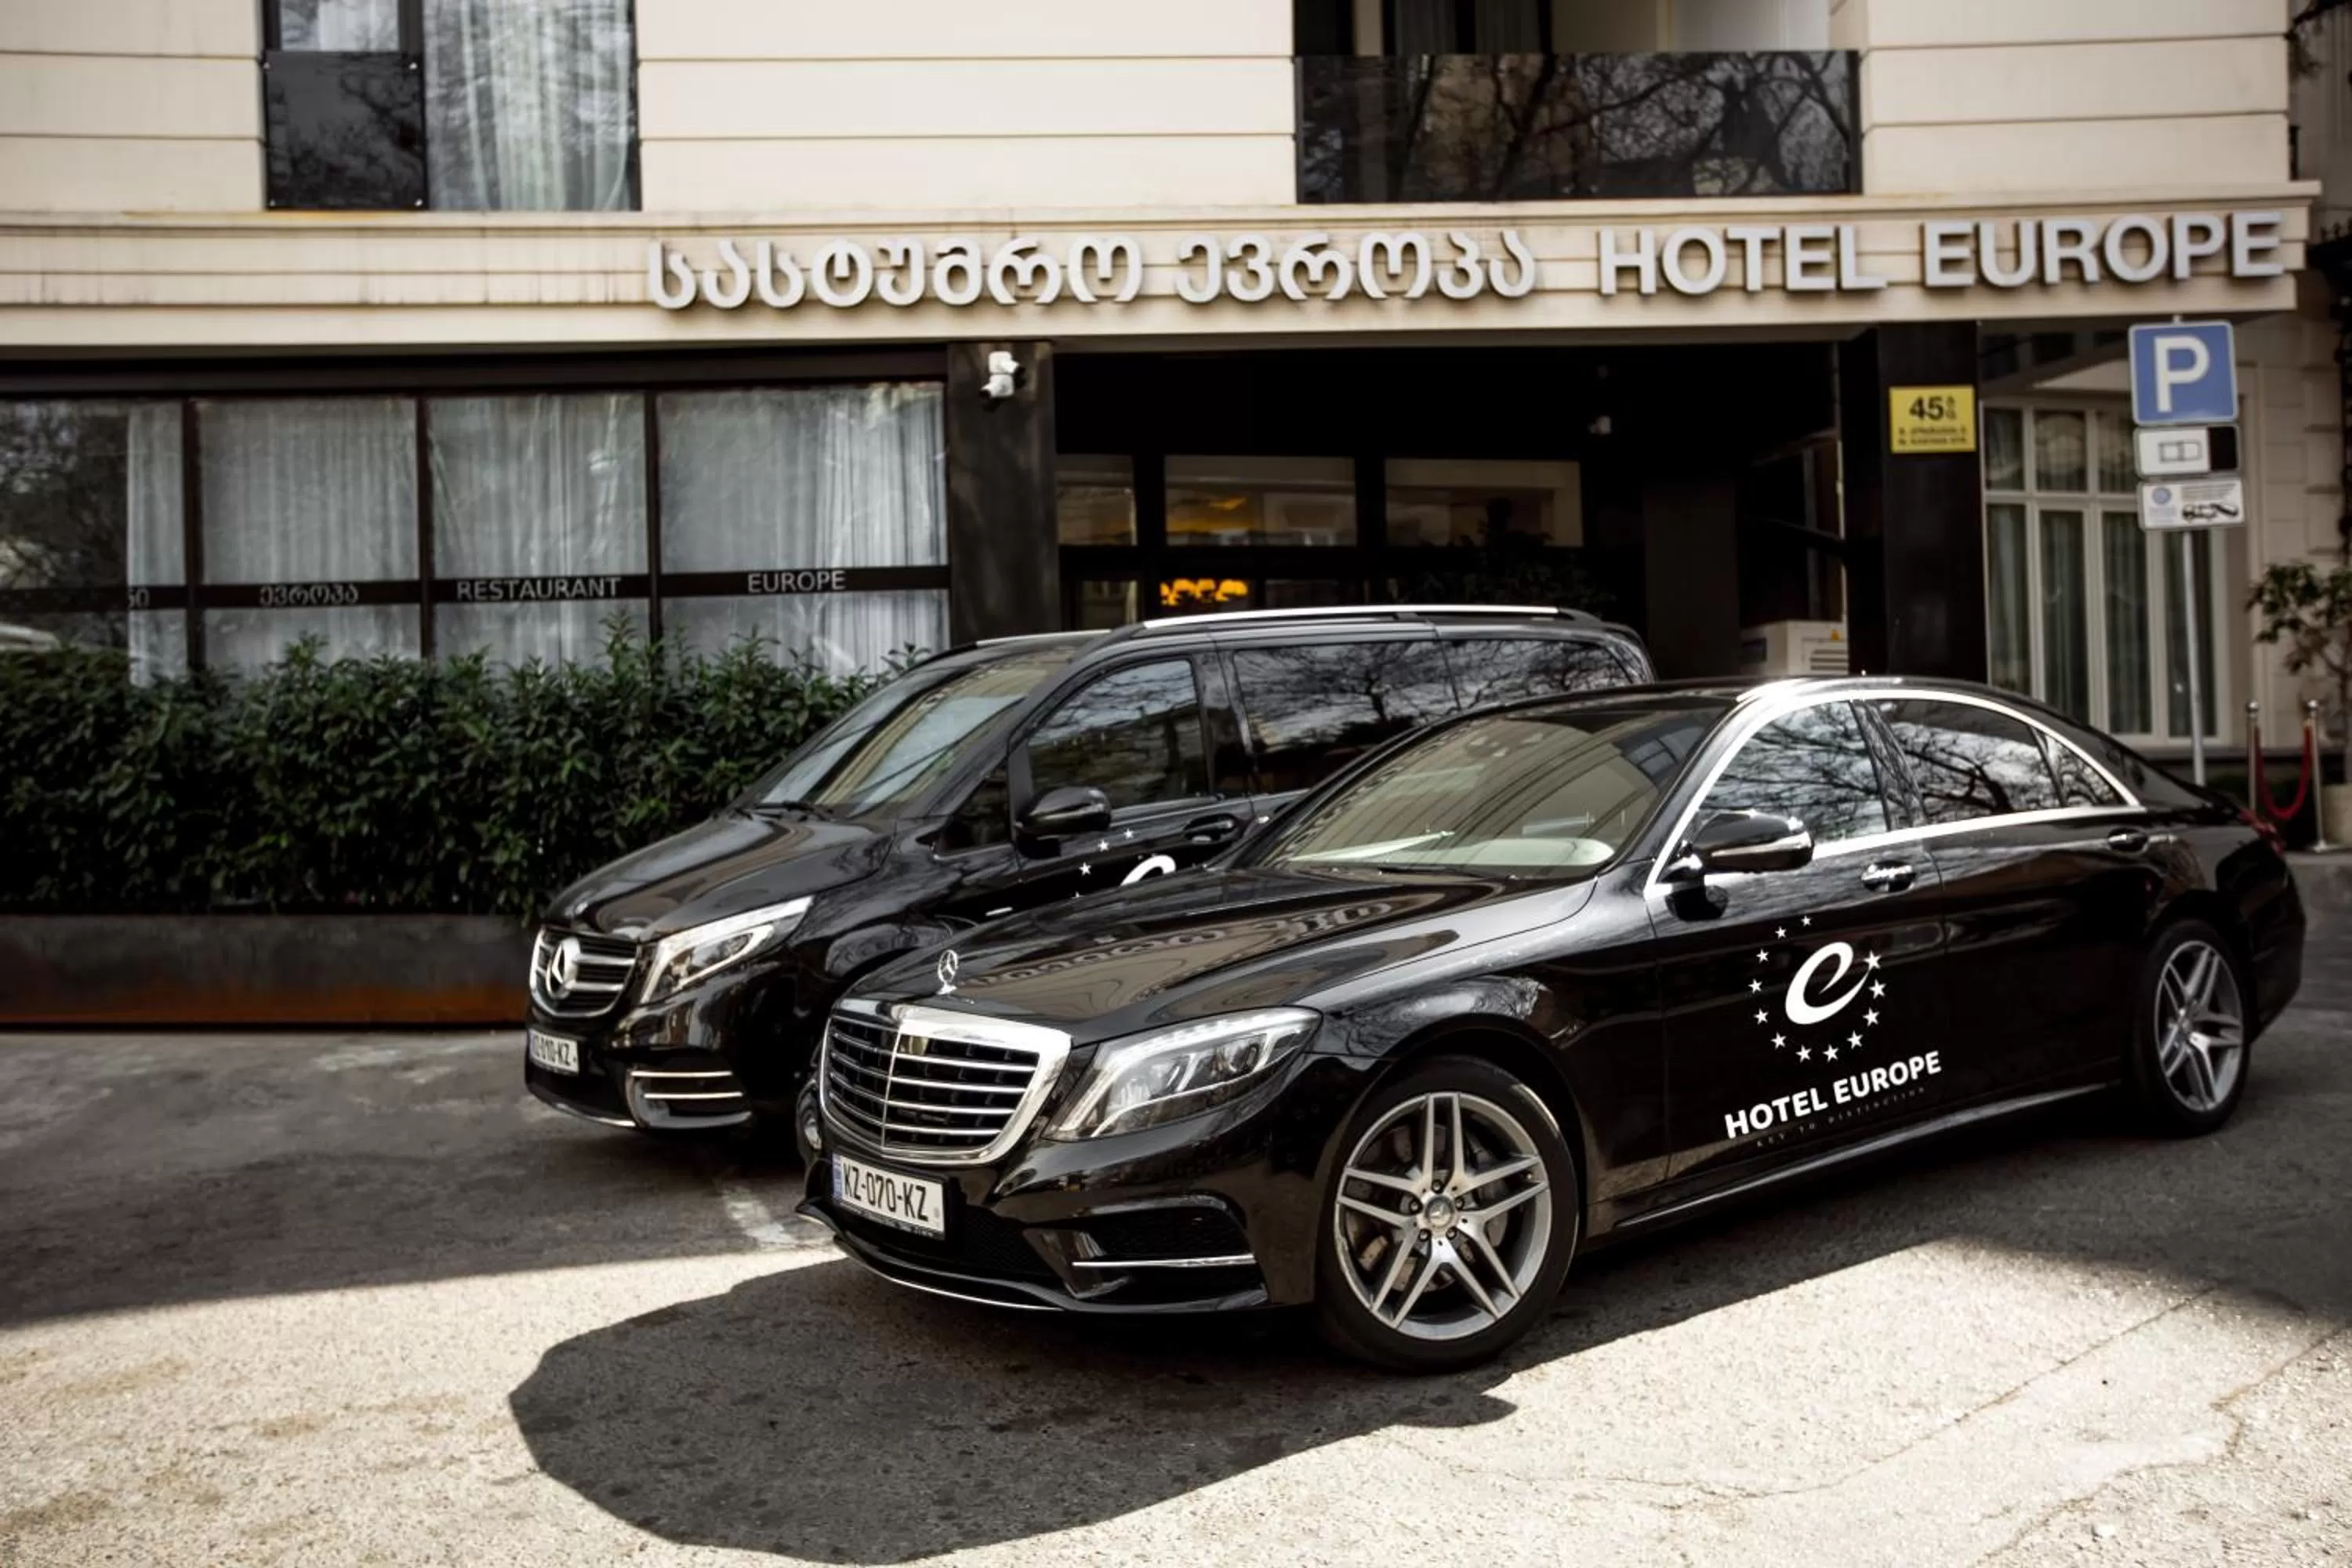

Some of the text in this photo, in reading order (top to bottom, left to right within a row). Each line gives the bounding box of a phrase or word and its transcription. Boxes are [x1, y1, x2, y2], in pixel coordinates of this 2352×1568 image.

[648, 230, 1535, 309] სასტუმრო ევროპა
[1599, 211, 2285, 296] HOTEL EUROPE
[2154, 336, 2209, 414] P
[457, 578, 621, 601] RESTAURANT
[747, 570, 847, 593] EUROPE
[1725, 1051, 1942, 1139] HOTEL EUROPE
[844, 1162, 929, 1221] KZ-070-KZ
